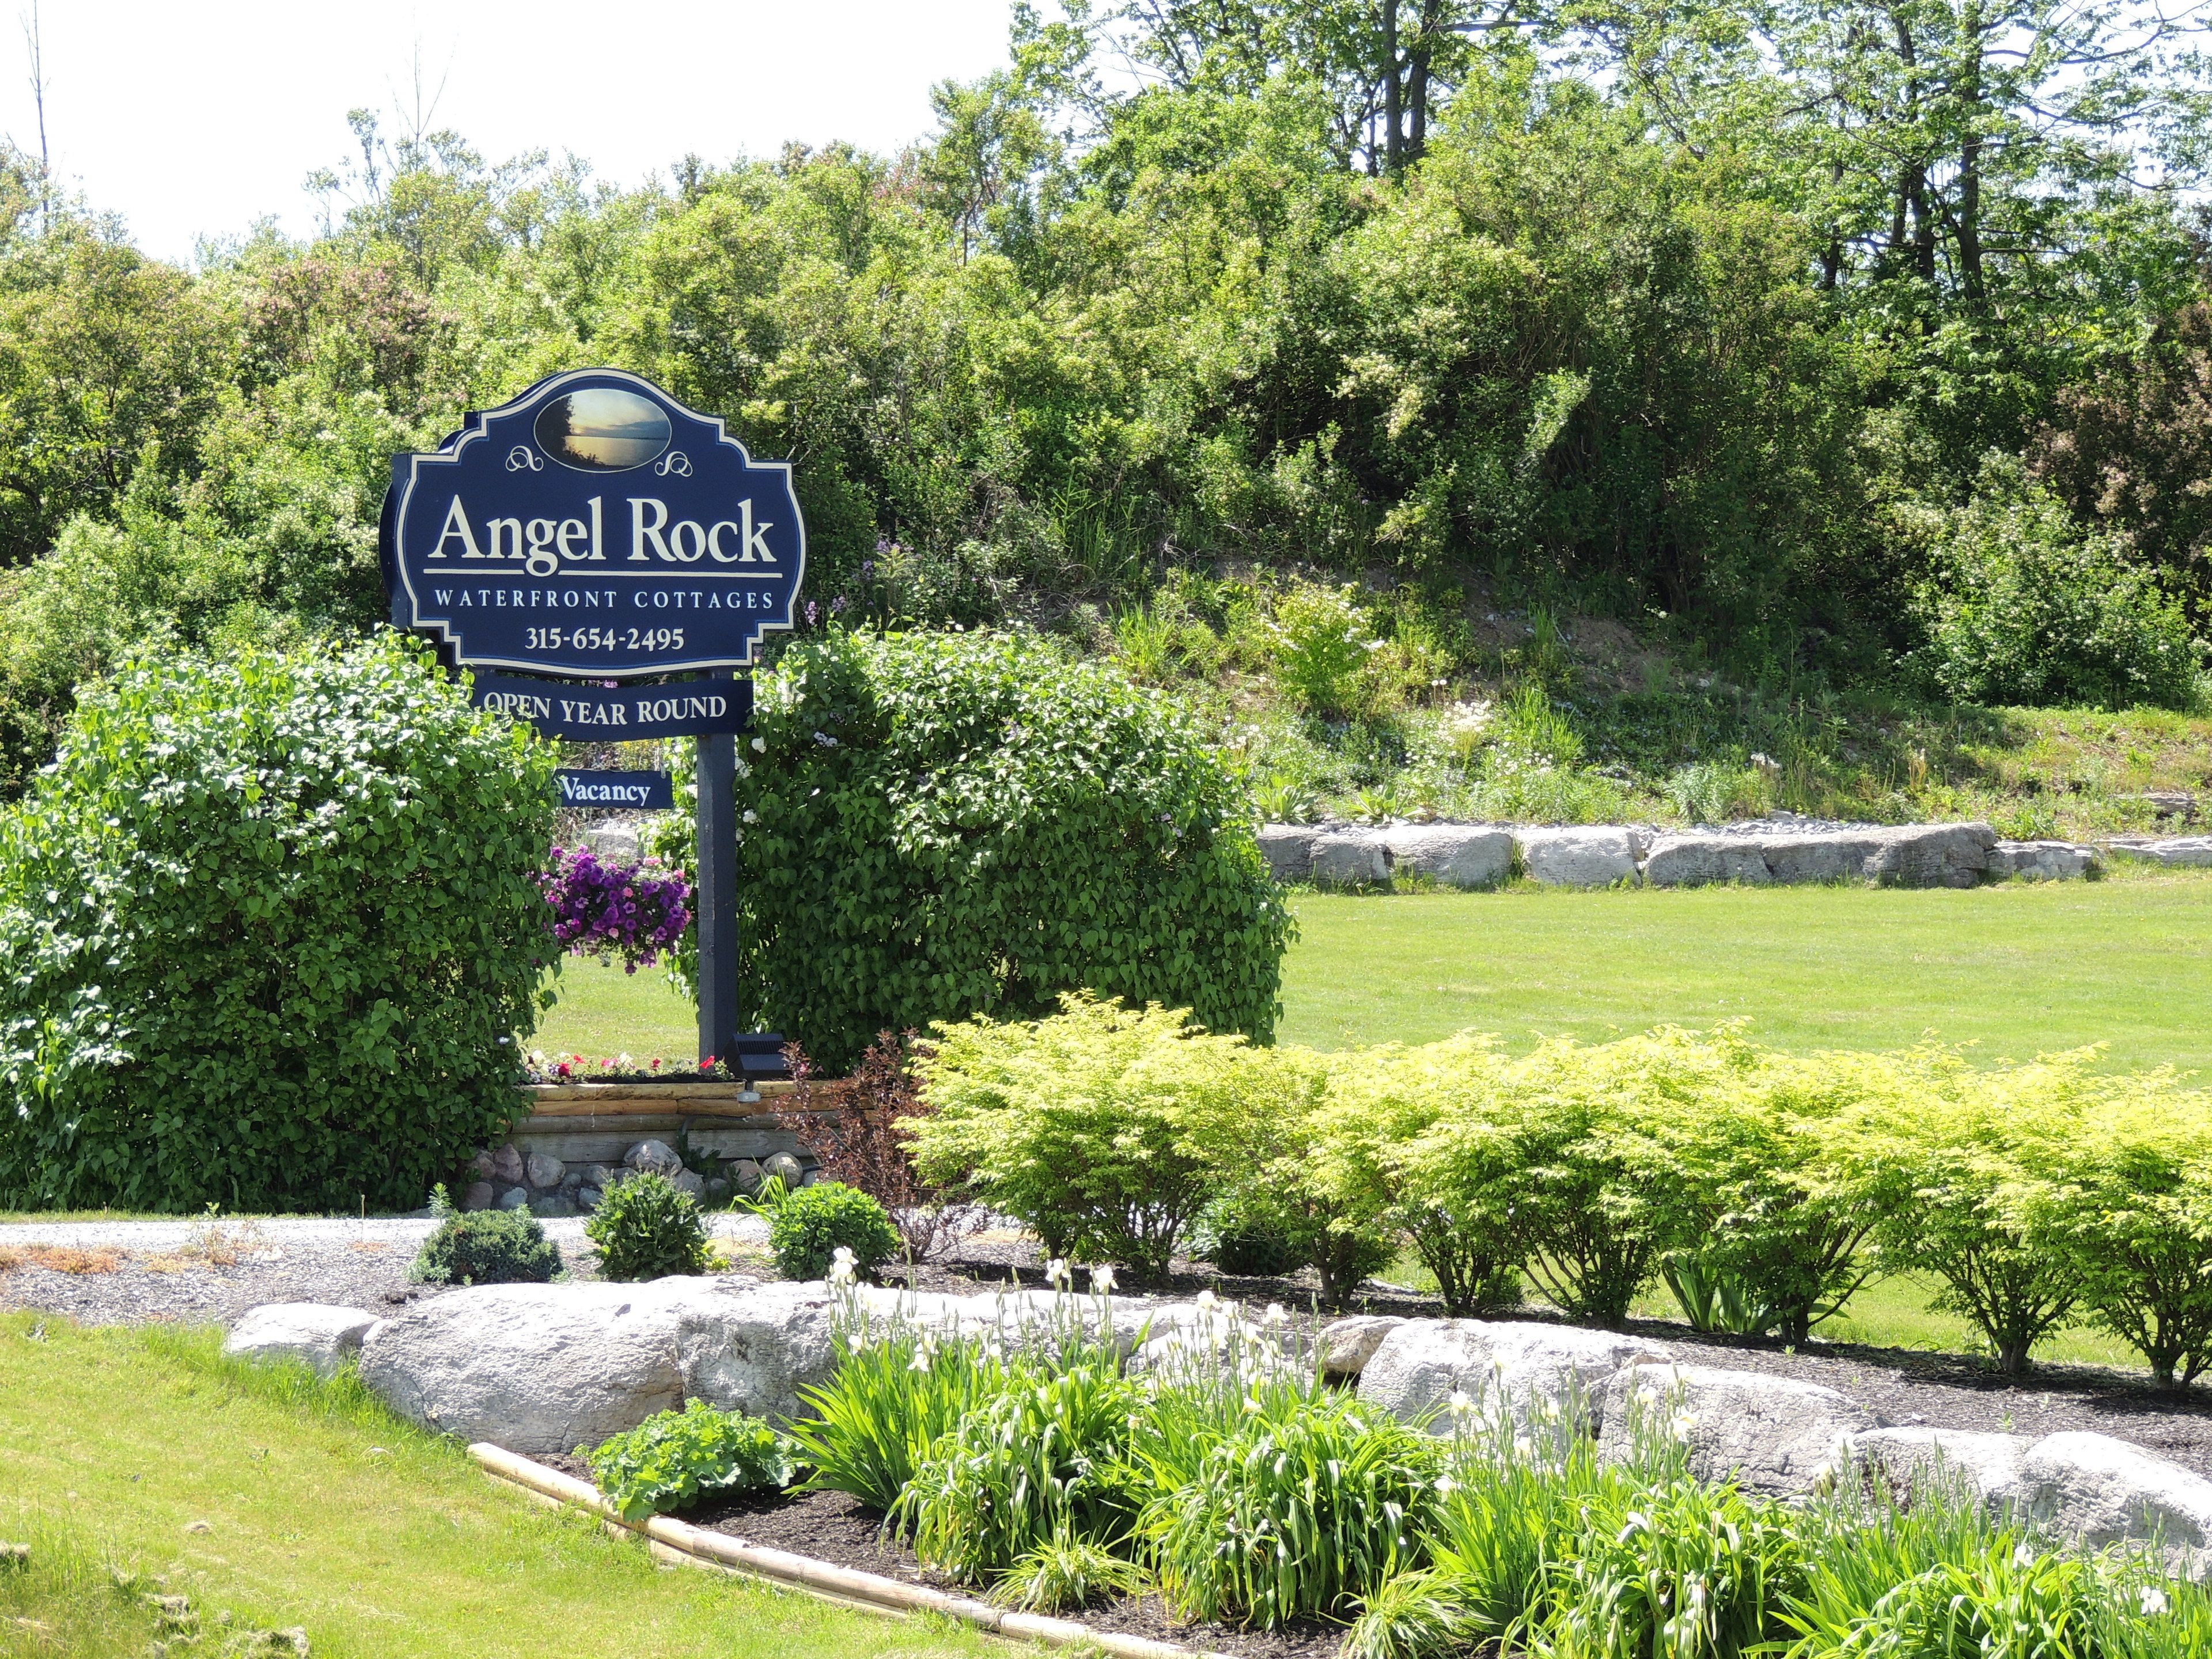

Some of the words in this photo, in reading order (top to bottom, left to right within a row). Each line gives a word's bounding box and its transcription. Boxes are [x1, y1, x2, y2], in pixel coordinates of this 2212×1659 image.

[427, 494, 607, 577] Angel
[626, 498, 778, 563] Rock
[435, 589, 618, 608] WATERFRONT
[634, 591, 773, 609] COTTAGES
[525, 627, 684, 651] 315-654-2495
[483, 691, 551, 719] OPEN
[559, 699, 628, 726] YEAR
[637, 695, 727, 723] ROUND
[562, 777, 652, 806] Vacancy
